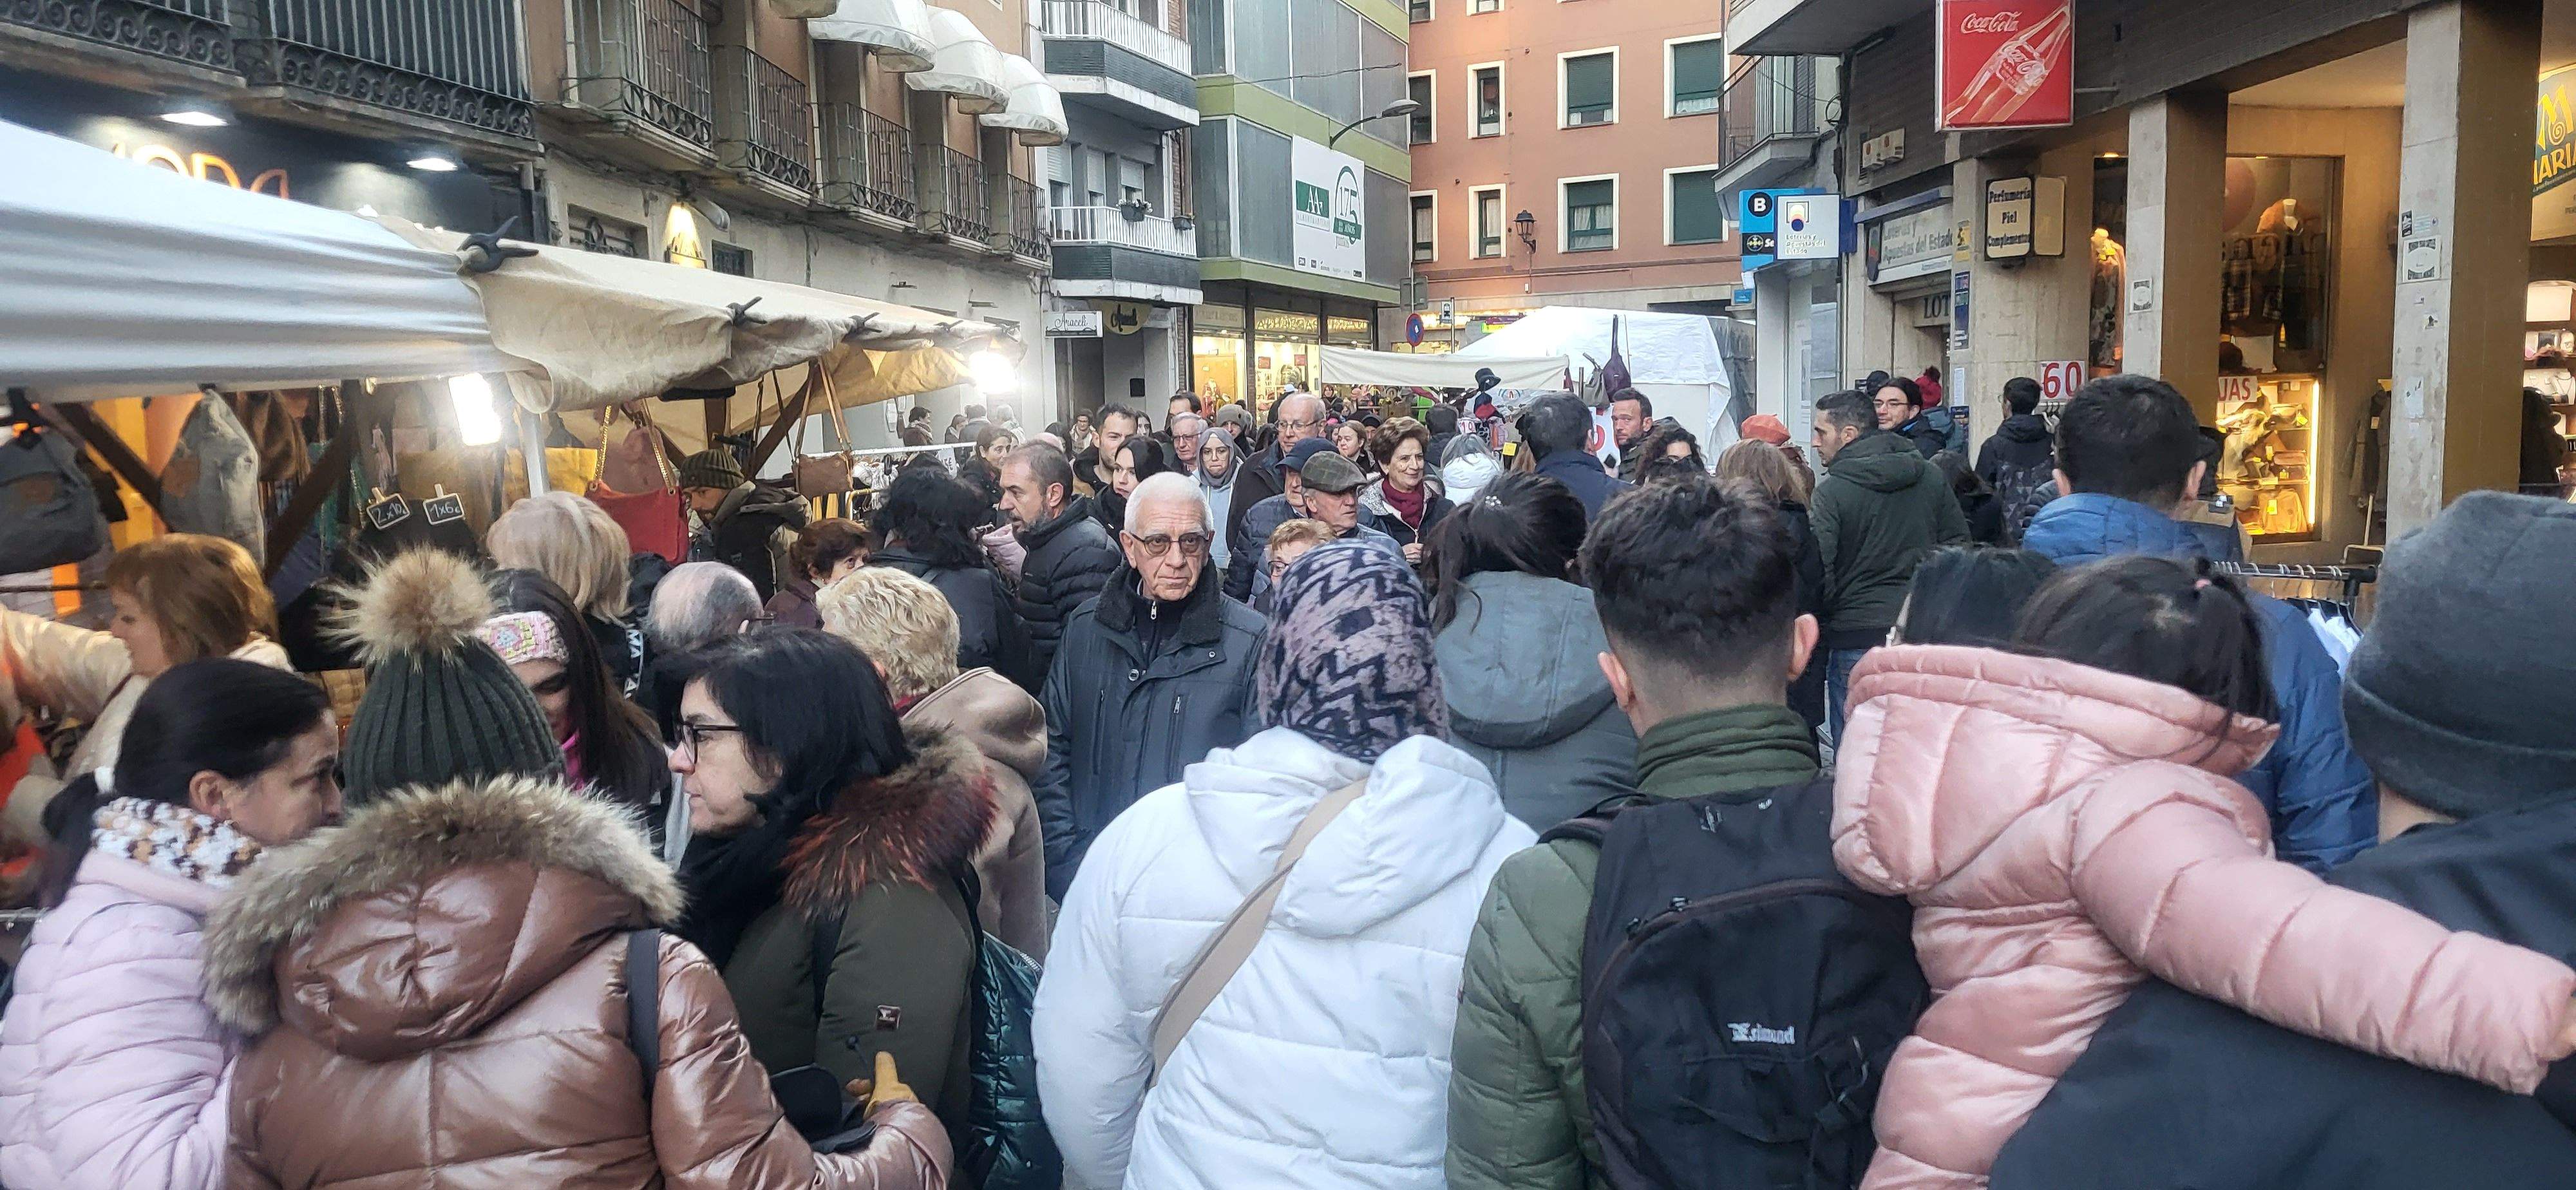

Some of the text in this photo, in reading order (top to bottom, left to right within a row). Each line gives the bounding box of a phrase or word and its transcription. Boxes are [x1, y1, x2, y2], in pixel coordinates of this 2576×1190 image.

[1754, 197, 1766, 212] B
[2002, 210, 2017, 224] Piel
[2043, 361, 2082, 399] 60
